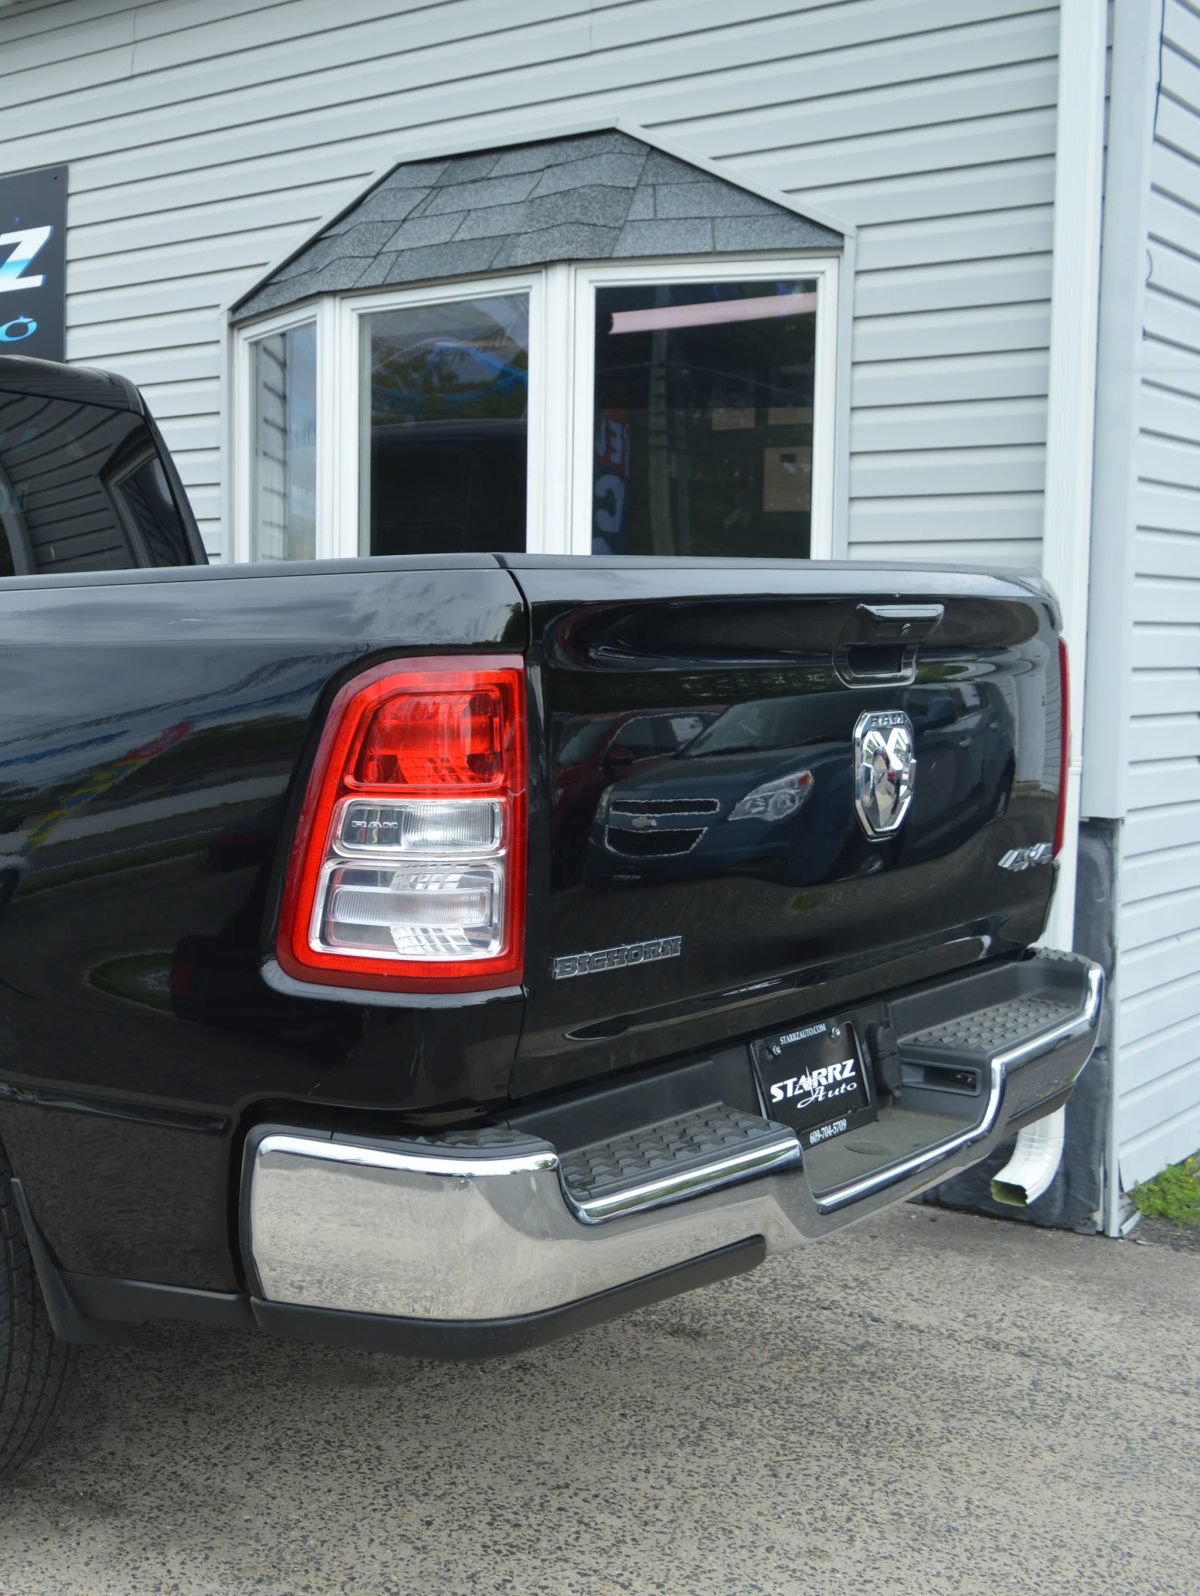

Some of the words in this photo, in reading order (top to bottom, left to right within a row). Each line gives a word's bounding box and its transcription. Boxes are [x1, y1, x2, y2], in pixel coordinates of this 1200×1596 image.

[870, 713, 905, 728] RAM
[351, 820, 399, 830] RAM
[779, 1023, 827, 1046] STARRZAUTO.COM
[770, 1058, 856, 1103] STARRZ
[796, 1082, 858, 1109] Auto
